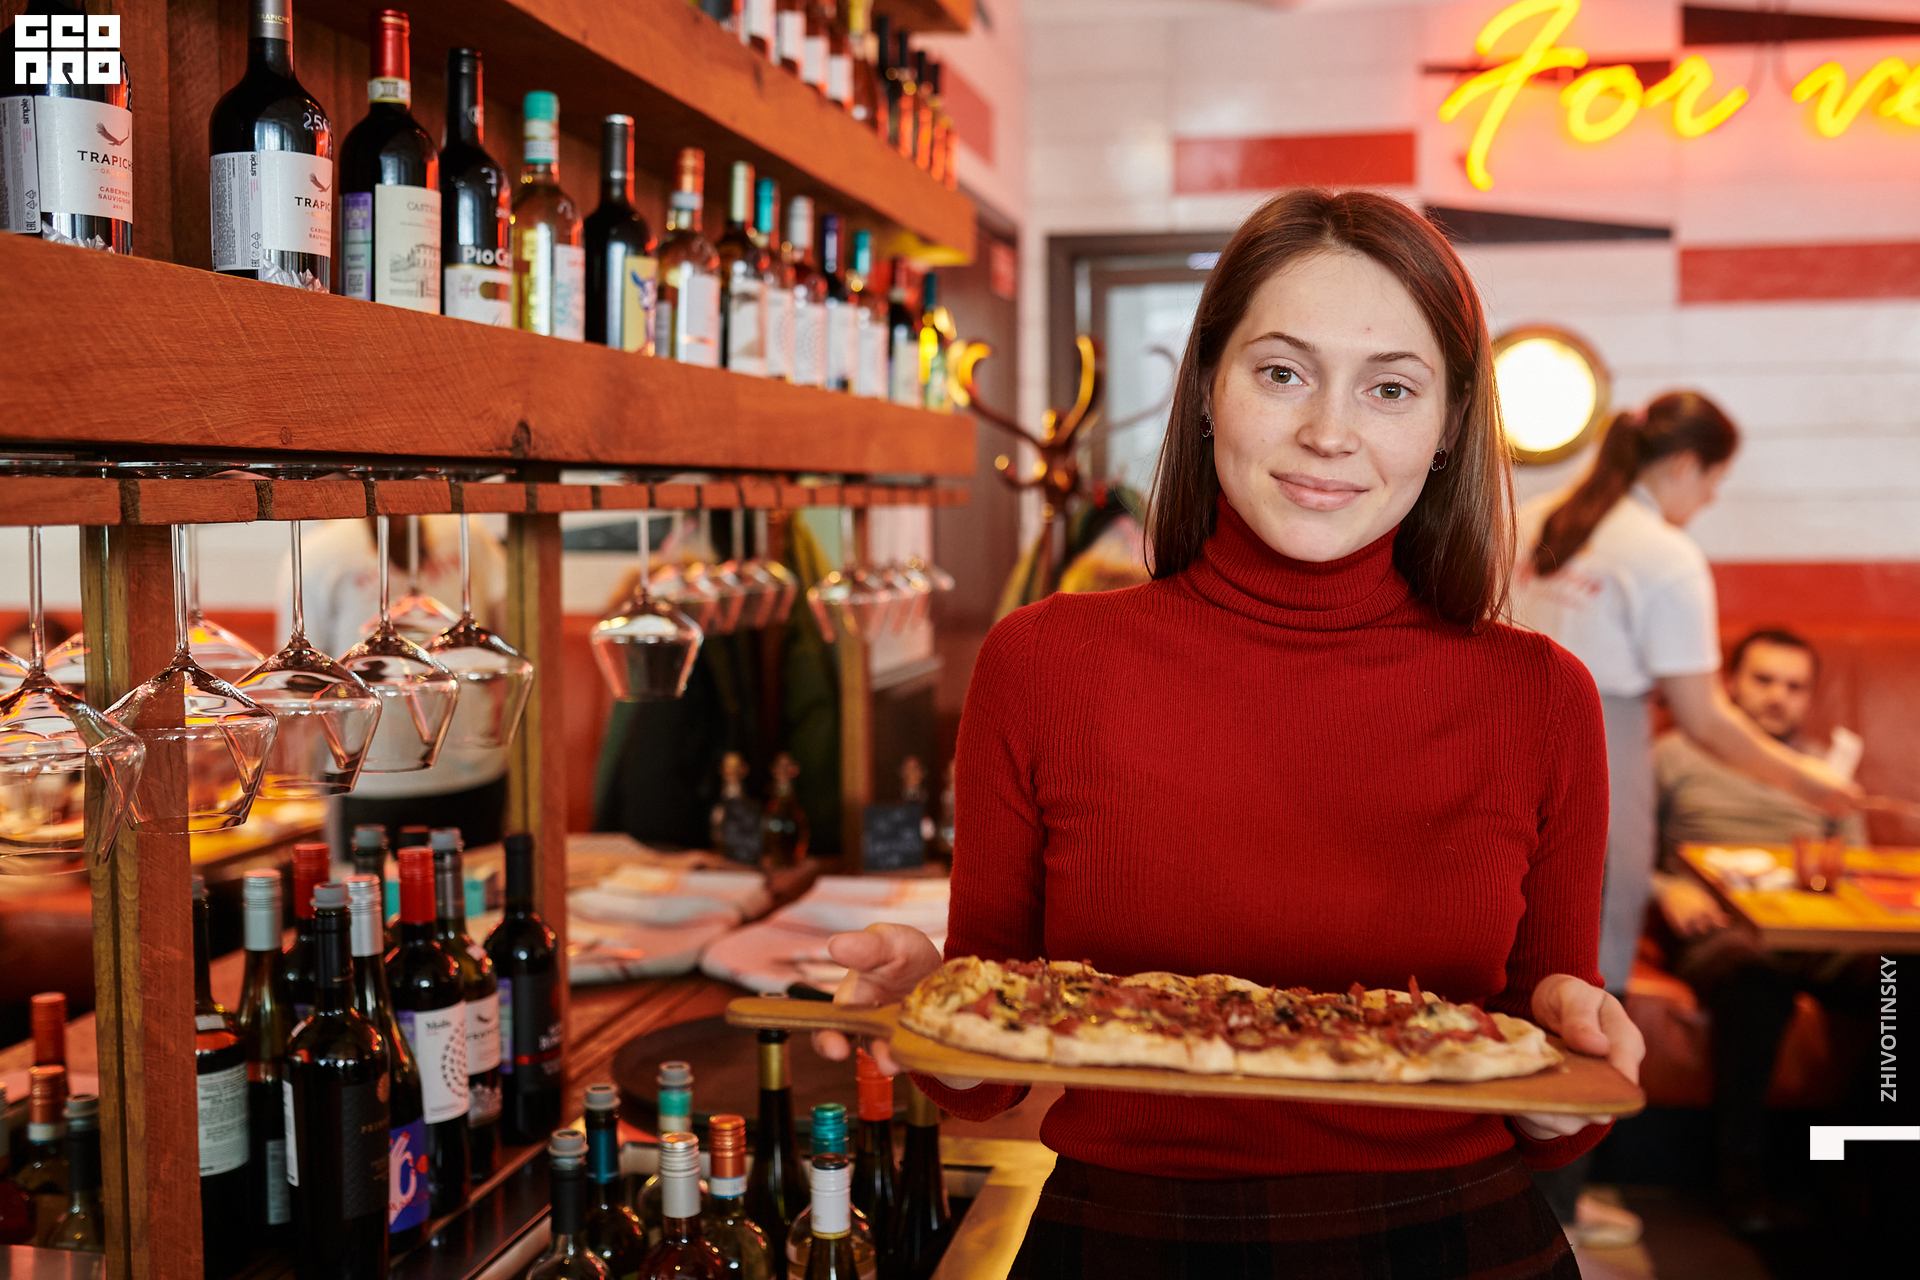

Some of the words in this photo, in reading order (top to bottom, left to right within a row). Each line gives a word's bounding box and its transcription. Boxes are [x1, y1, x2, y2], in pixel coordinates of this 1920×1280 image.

[1438, 0, 1748, 191] For
[21, 98, 30, 125] simple
[249, 154, 258, 177] simple
[97, 193, 131, 205] SAUVIGNON
[99, 186, 130, 198] CABERNET
